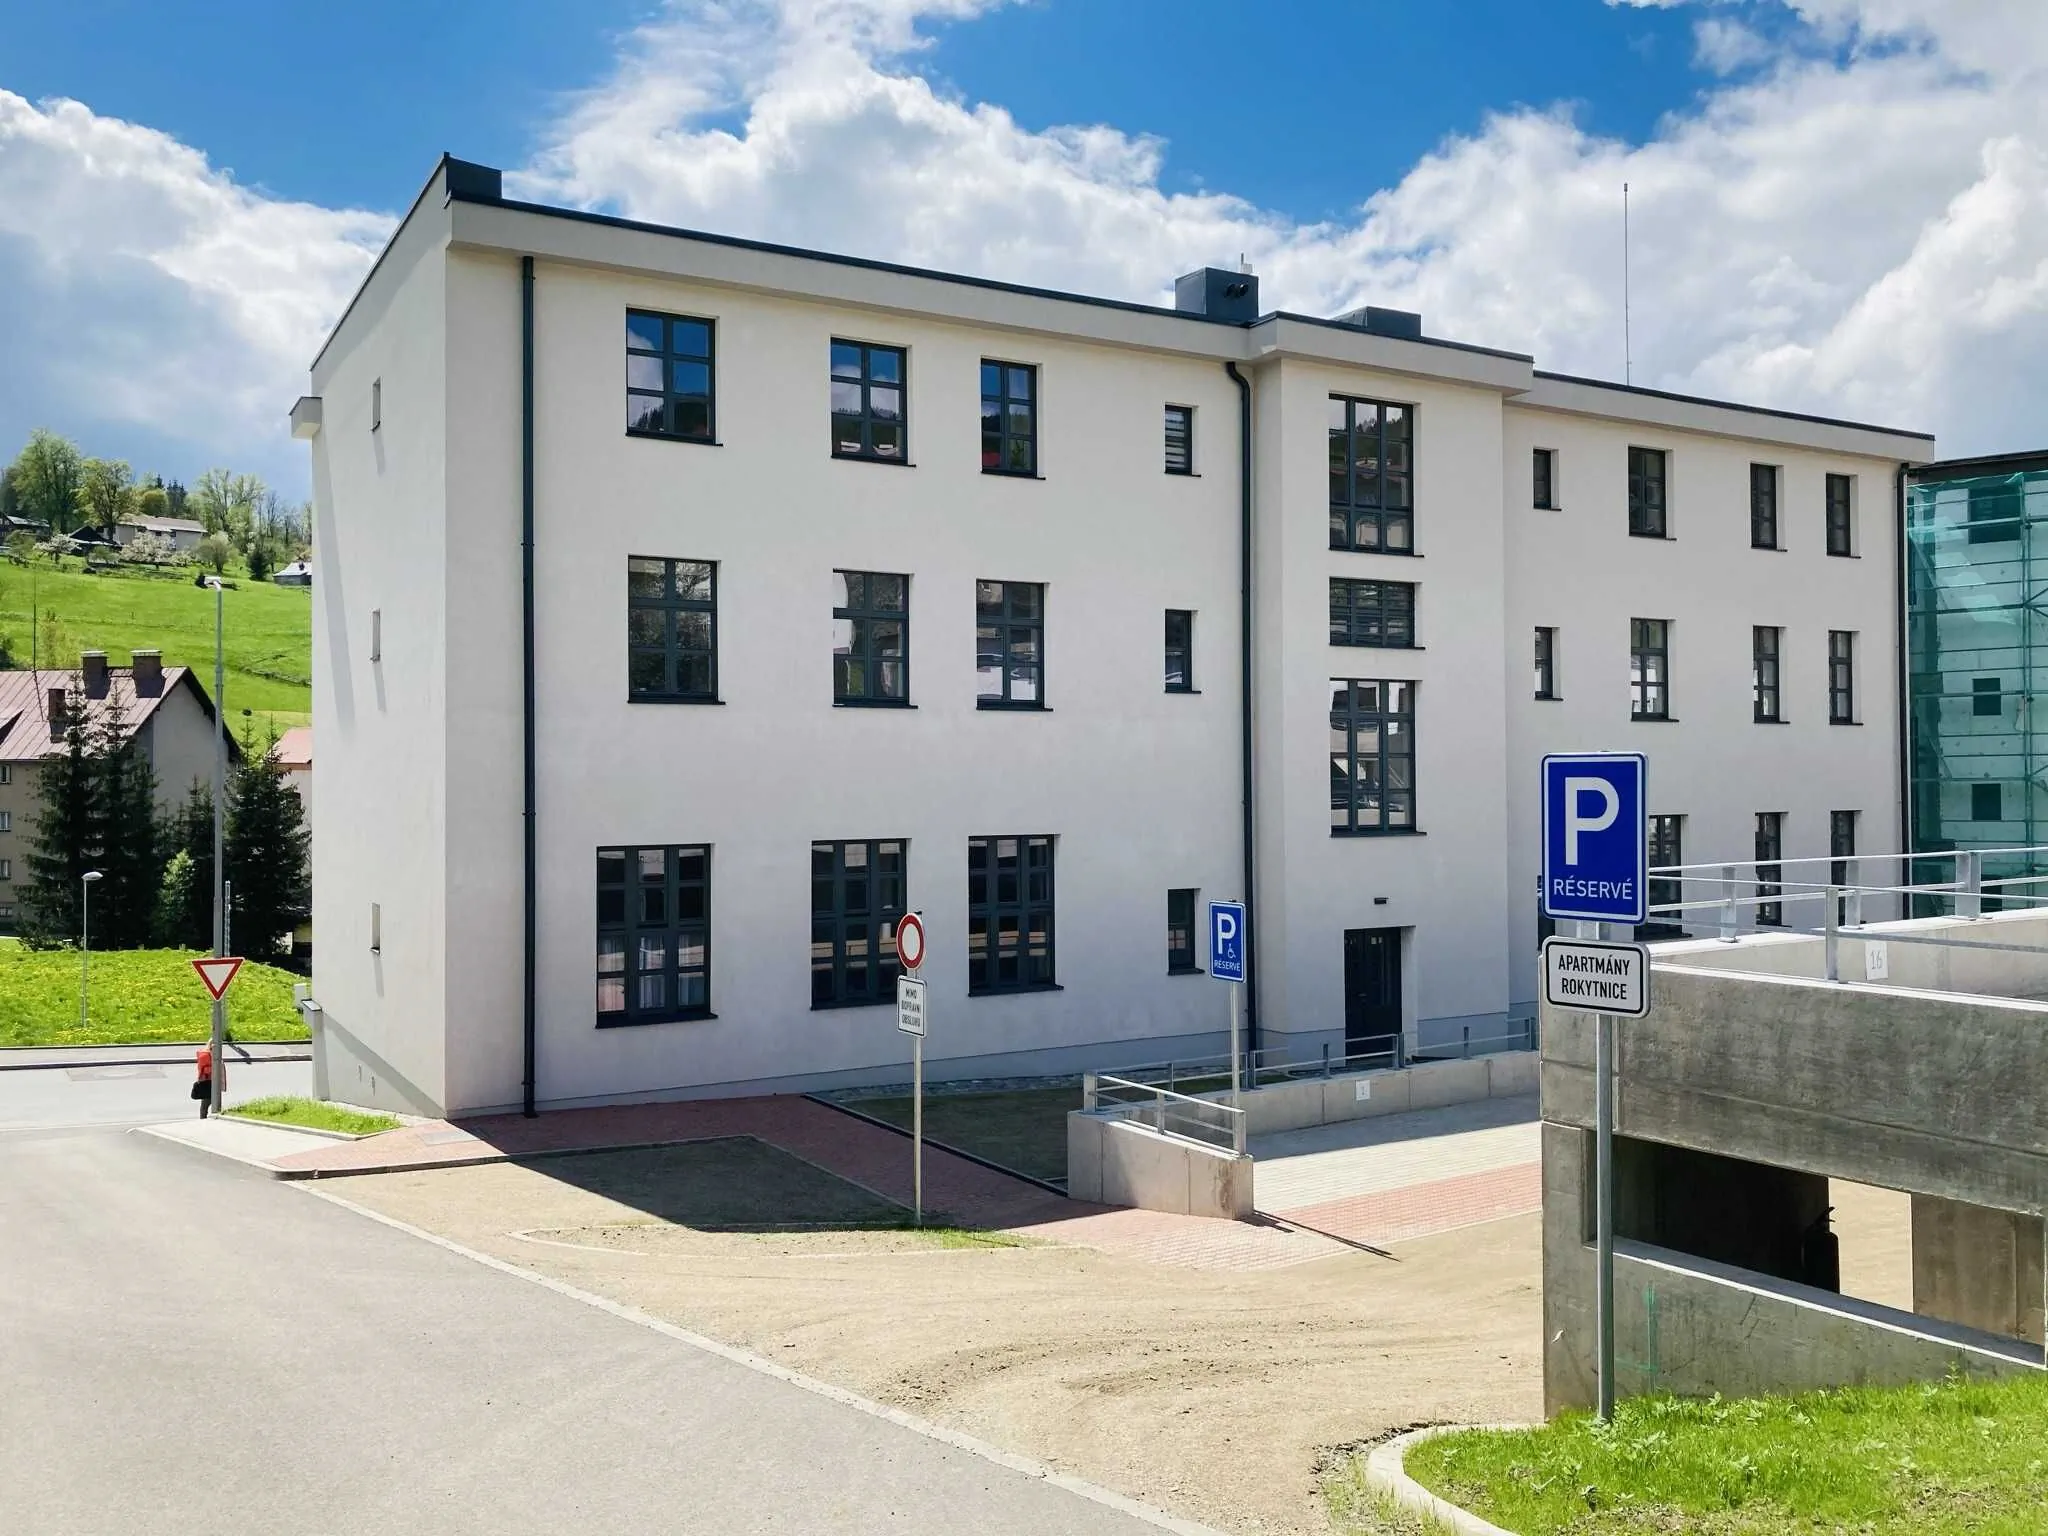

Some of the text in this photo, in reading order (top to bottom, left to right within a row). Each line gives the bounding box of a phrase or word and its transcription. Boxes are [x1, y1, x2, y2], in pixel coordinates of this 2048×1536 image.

[1565, 776, 1619, 865] P
[1553, 875, 1633, 900] RÉSERVÉ
[1217, 912, 1236, 955] P
[1558, 954, 1630, 976] APARTMÁNY
[1561, 978, 1627, 1000] ROKYTNICE
